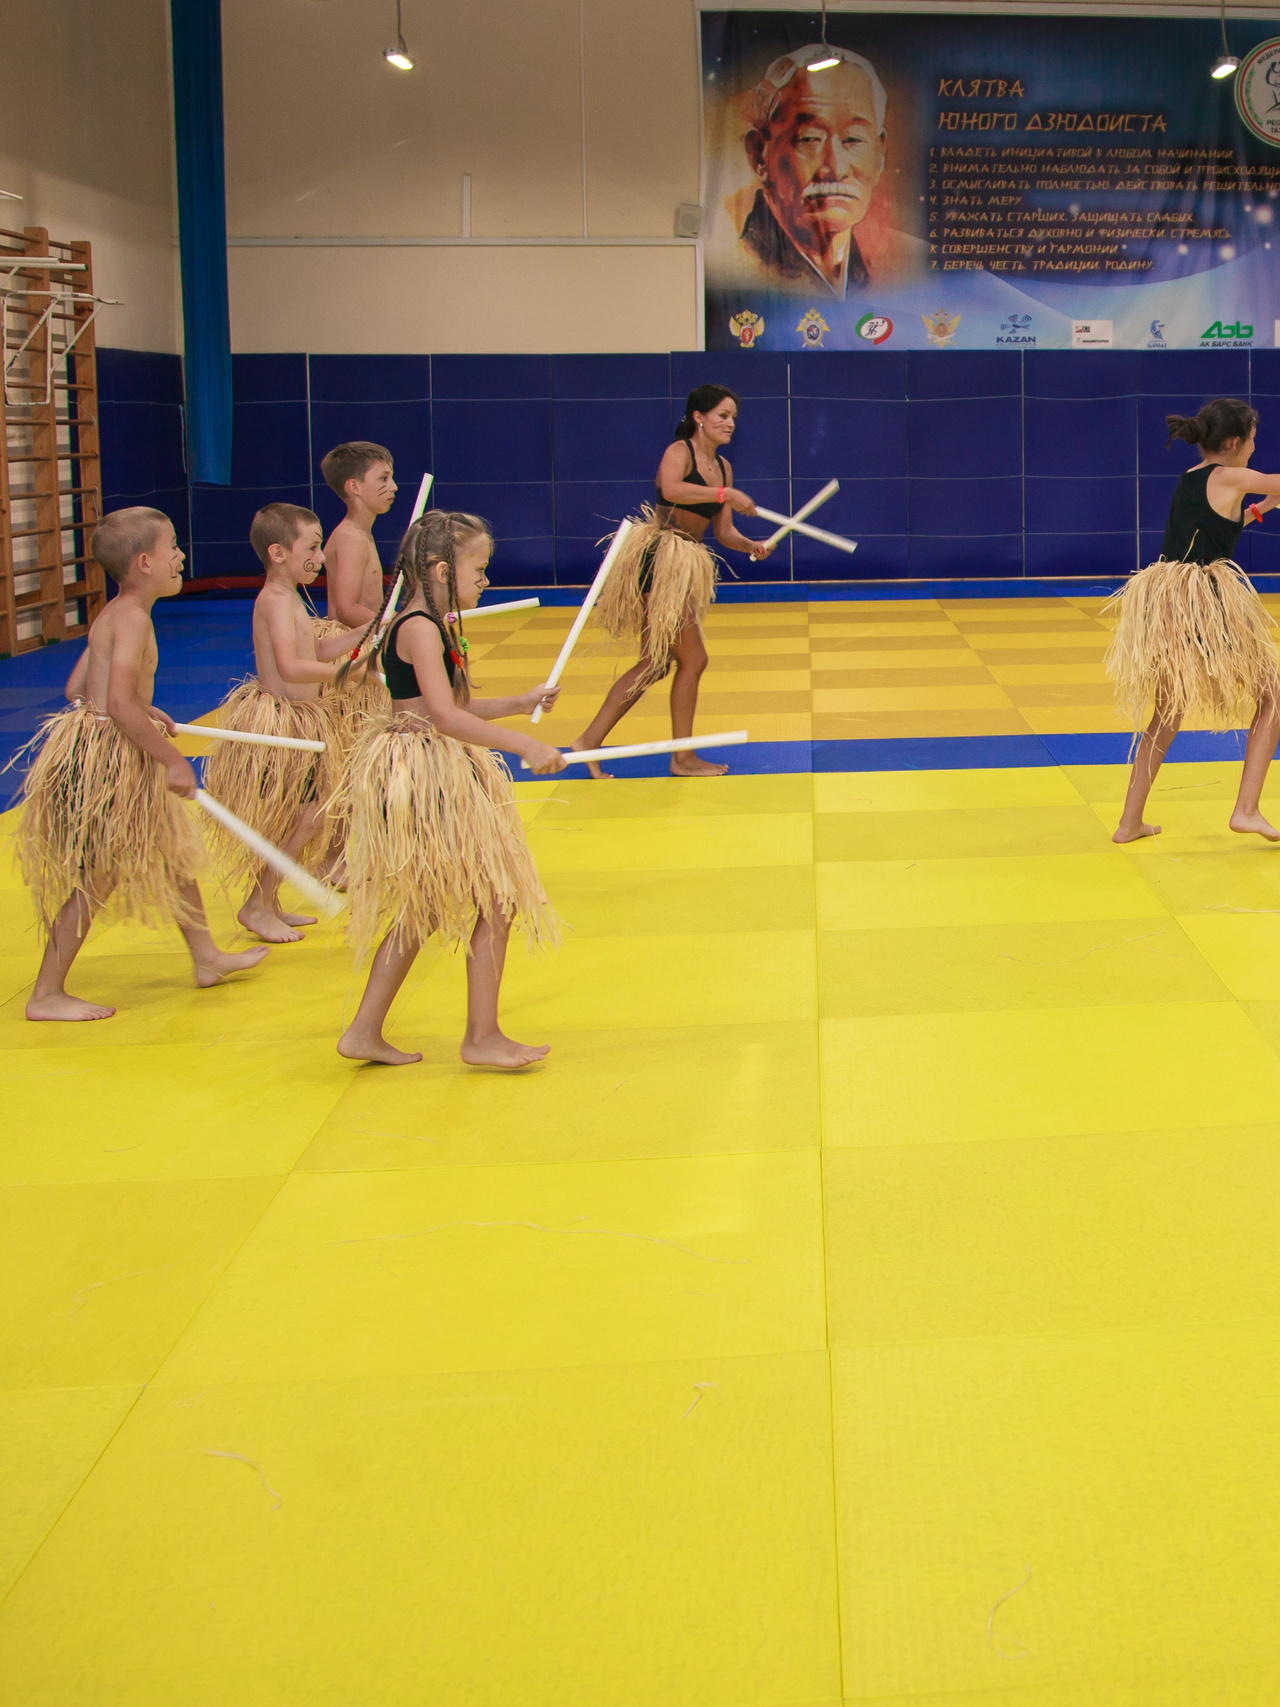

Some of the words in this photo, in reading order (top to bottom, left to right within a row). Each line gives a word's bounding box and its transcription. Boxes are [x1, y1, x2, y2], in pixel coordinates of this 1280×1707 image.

[937, 78, 1025, 98] КЛЯТВА
[937, 112, 1018, 131] ЮНОГО
[1025, 112, 1168, 132] ДЗЮДОИСТА
[941, 147, 997, 157] ВЛАДЕТЬ
[1001, 146, 1093, 160] ИНИЦИАТИВОЙ
[1096, 148, 1103, 158] В
[1106, 148, 1152, 158] ЛЮБОМ
[942, 163, 1037, 173] ВНИМАТЕЛЬНО
[1041, 163, 1121, 174] НАБЛЮДАТЬ
[1124, 164, 1140, 174] ЗА
[1144, 163, 1181, 174] СОБОЙ
[1184, 165, 1193, 174] И
[942, 180, 1031, 190] ОСМЫСЛИВАТЬ
[1115, 178, 1198, 191] ДЕЙСТВОВАТЬ
[943, 195, 982, 205] ЗНАТЬ
[944, 211, 1003, 222] УВАЖАТЬ
[1072, 212, 1142, 225] ЗАЩИЩАТЬ
[943, 227, 1024, 238] РАЗВИВАТЬСЯ
[1027, 228, 1082, 238] ДУХОВНО
[1085, 228, 1095, 238] И
[1170, 228, 1232, 238] СТРЕМЯСЬ
[929, 244, 938, 254] К
[941, 244, 1034, 254] СОВЕРШЕНСТВУ
[1037, 244, 1046, 253] И
[943, 260, 985, 270] БЕРЕЧЬ
